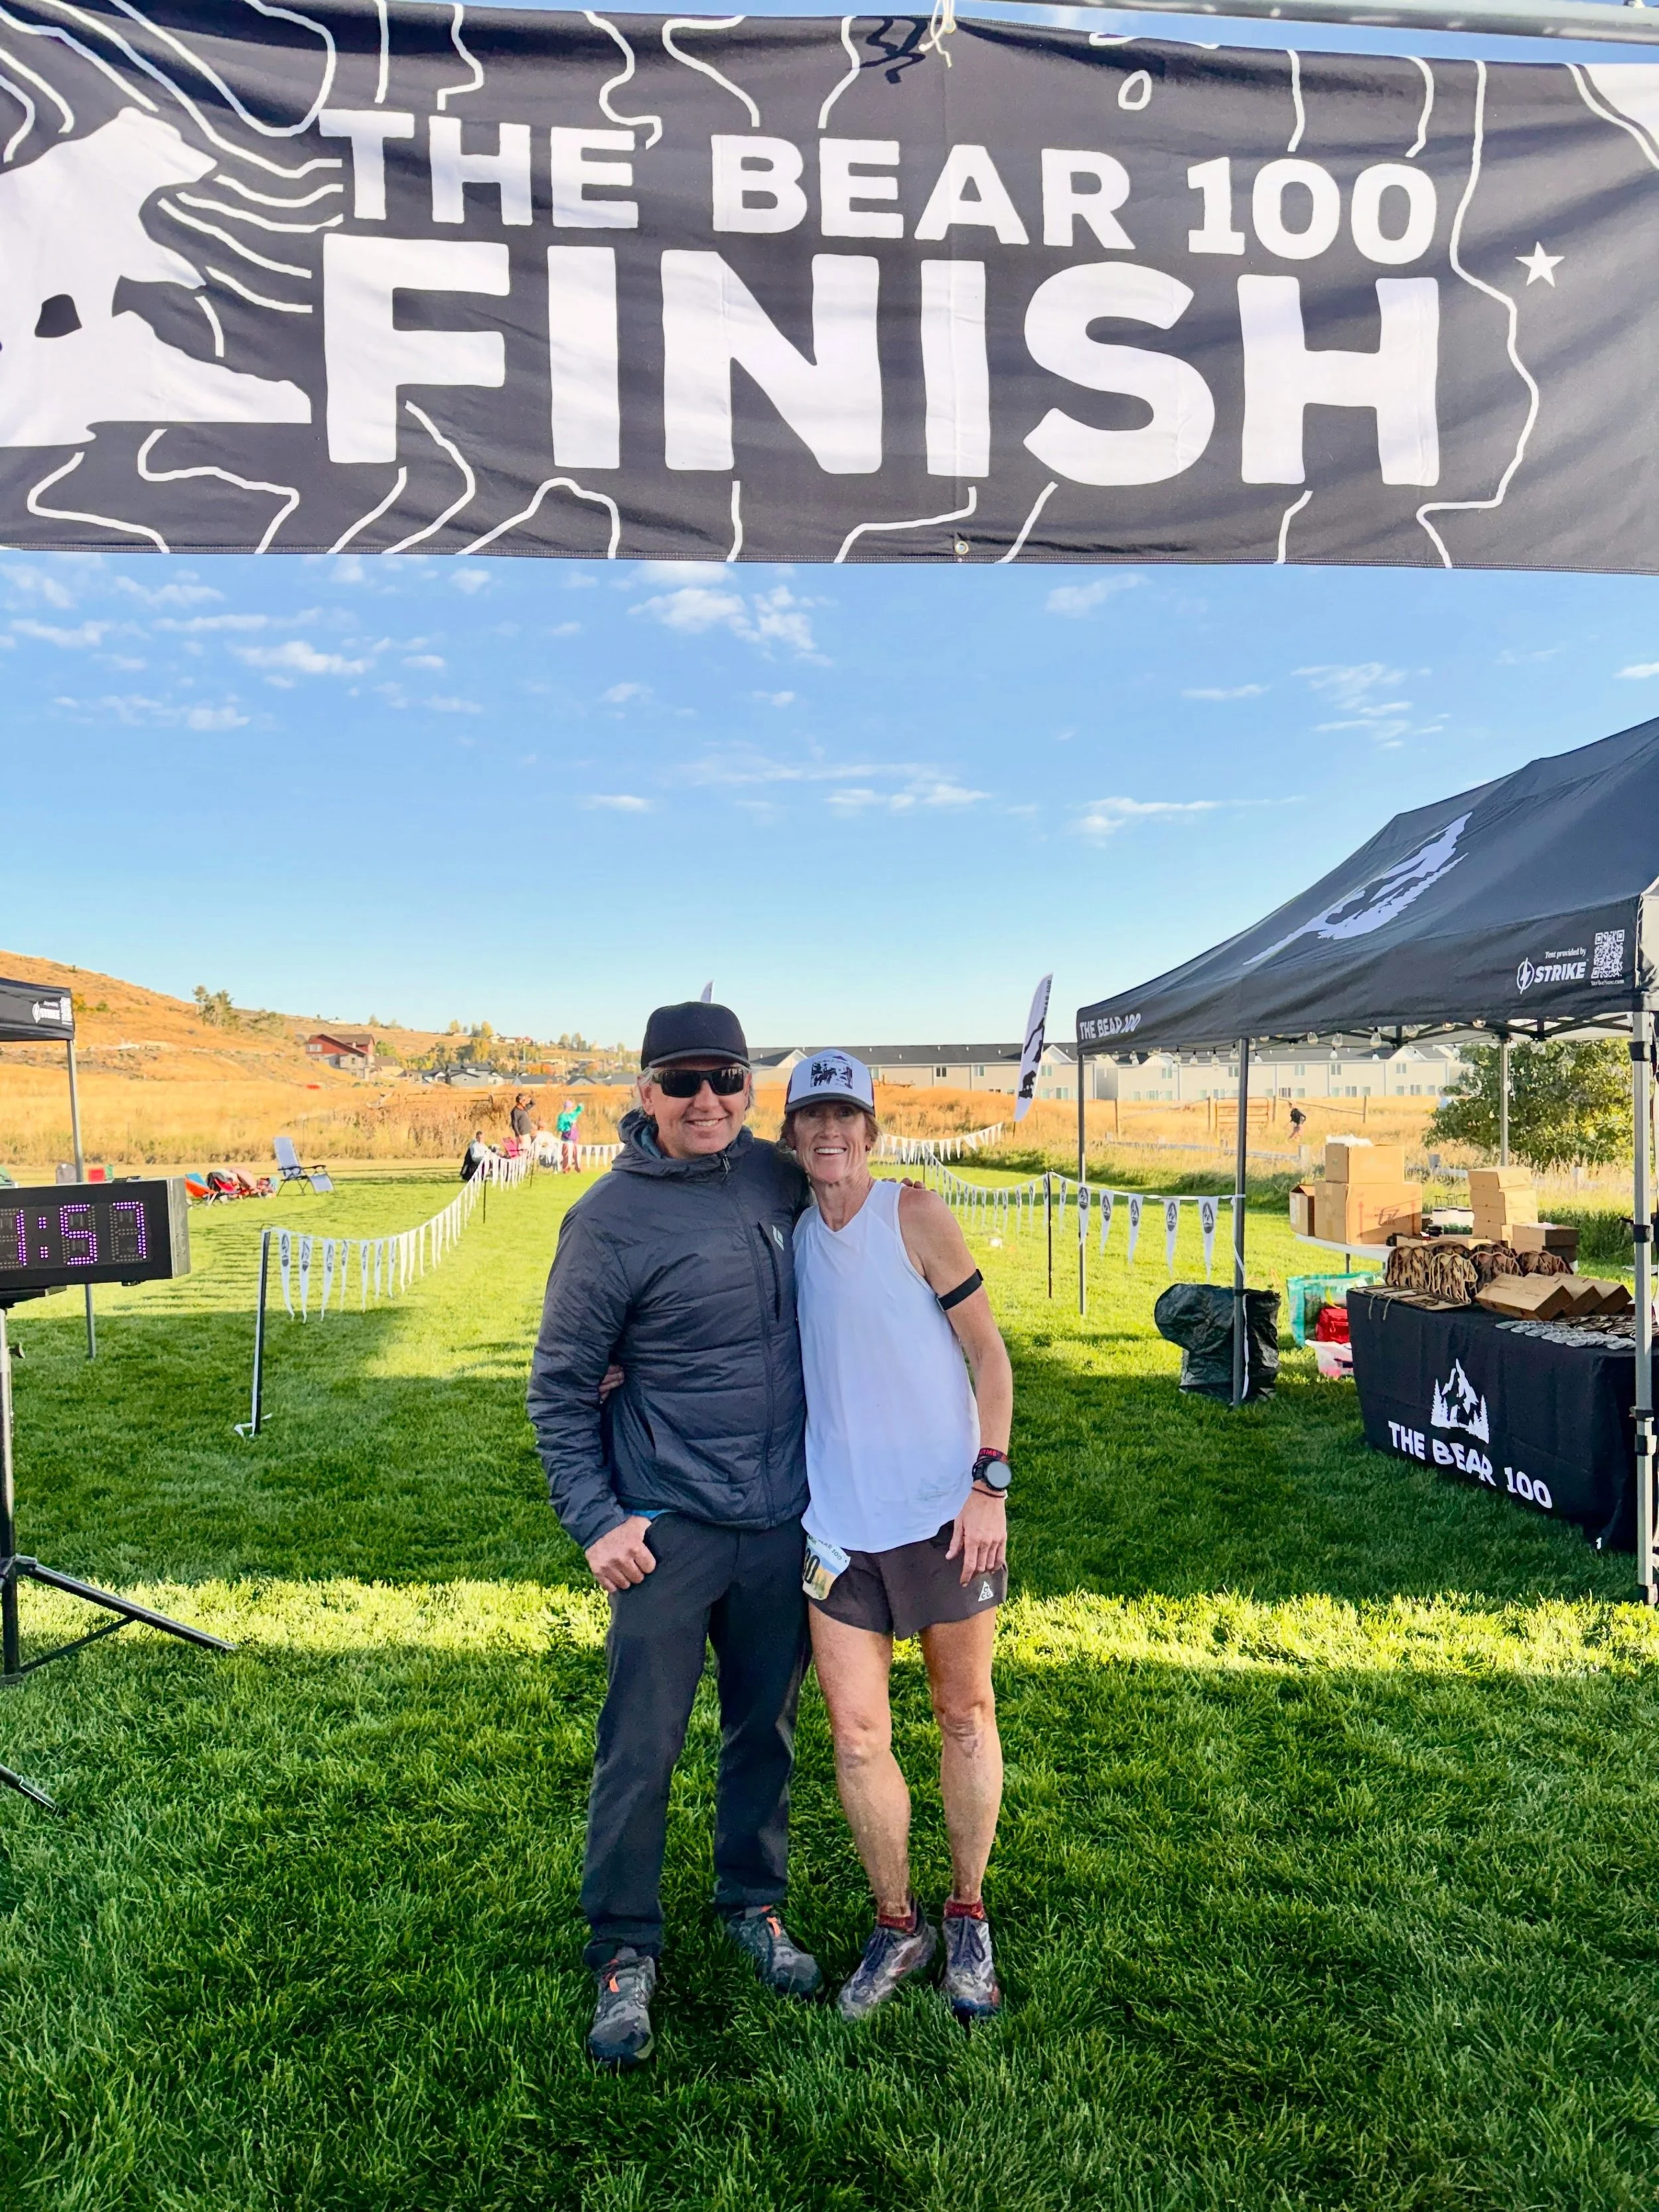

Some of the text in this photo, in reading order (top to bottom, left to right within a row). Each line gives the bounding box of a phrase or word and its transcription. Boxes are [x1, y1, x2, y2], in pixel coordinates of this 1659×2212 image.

[319, 109, 1437, 264] THE BEAR 100
[323, 234, 1440, 486] FINISH
[1556, 948, 1579, 959] provided
[1579, 946, 1587, 956] by
[1534, 962, 1587, 983] STRIKE
[1079, 1020, 1096, 1040] THE
[1388, 1420, 1553, 1509] THE BEAR 100
[831, 1548, 842, 1561] 100
